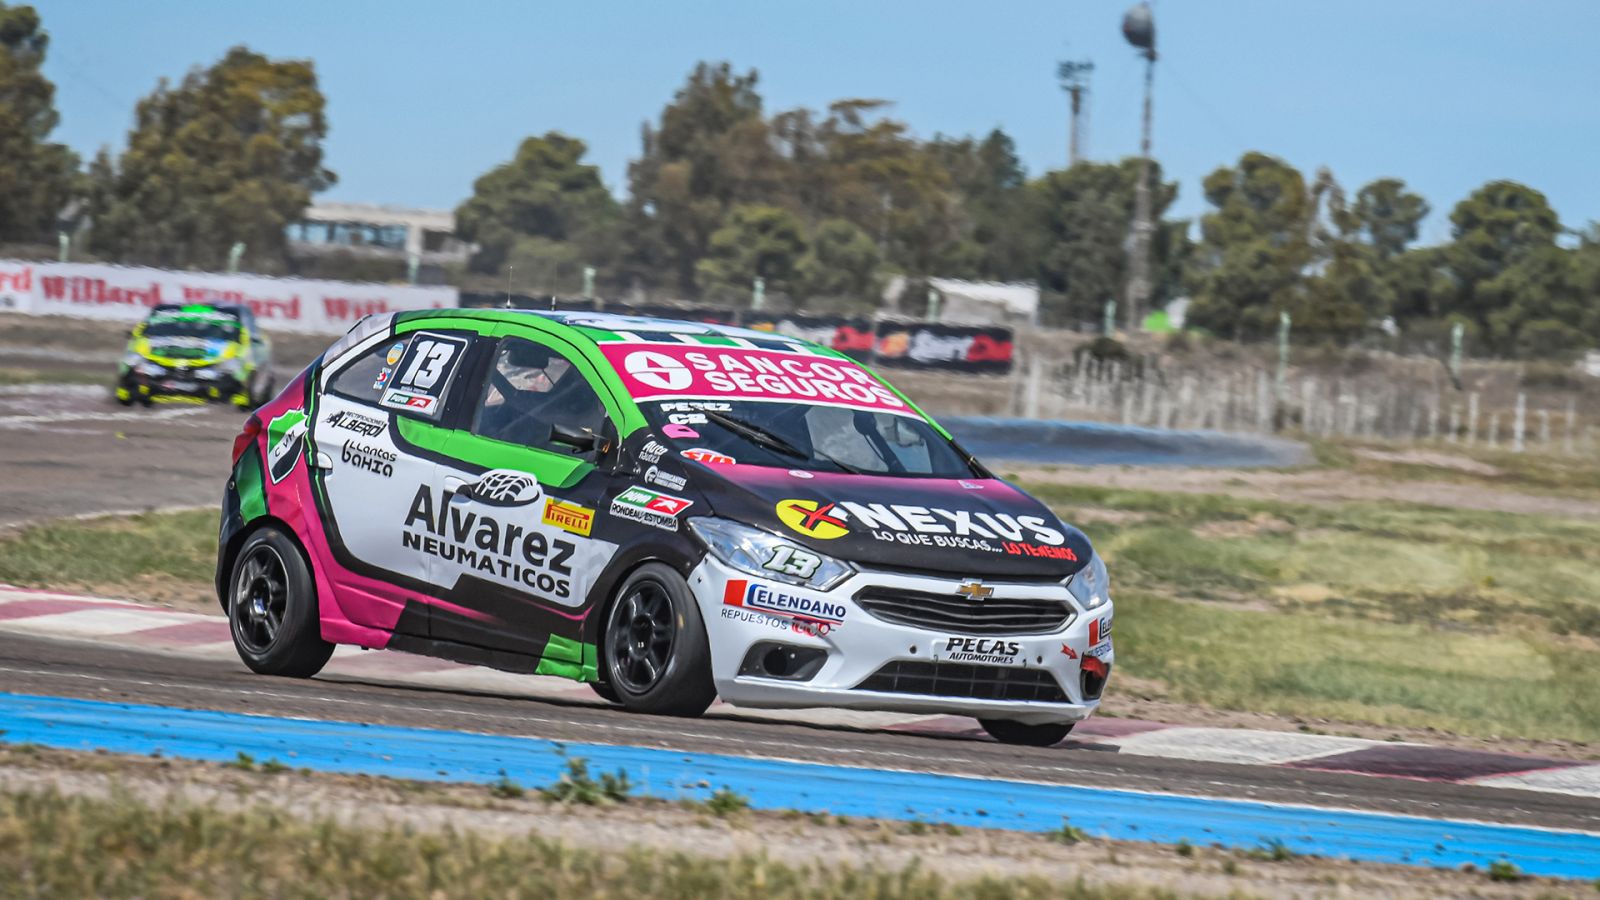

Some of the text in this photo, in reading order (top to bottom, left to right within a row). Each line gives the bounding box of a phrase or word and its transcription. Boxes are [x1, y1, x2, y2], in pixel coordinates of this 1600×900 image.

[42, 276, 161, 306] Willard
[400, 340, 455, 389] 13
[684, 351, 882, 387] SANCOR
[703, 371, 904, 407] SEGUROS
[404, 483, 576, 577] Alvarez
[545, 503, 590, 530] PIRELLI
[830, 501, 1065, 545] NEXUS
[872, 529, 894, 542] LO
[894, 533, 932, 546] QUE
[936, 536, 1003, 553] BUSCAS...
[1002, 541, 1021, 555] LO
[402, 530, 571, 598] NEUMATICOS
[762, 545, 822, 579] 13
[721, 608, 787, 630] REPUESTOS
[945, 637, 1020, 656] PECAS
[949, 652, 1014, 665] AUTOMOTORES
